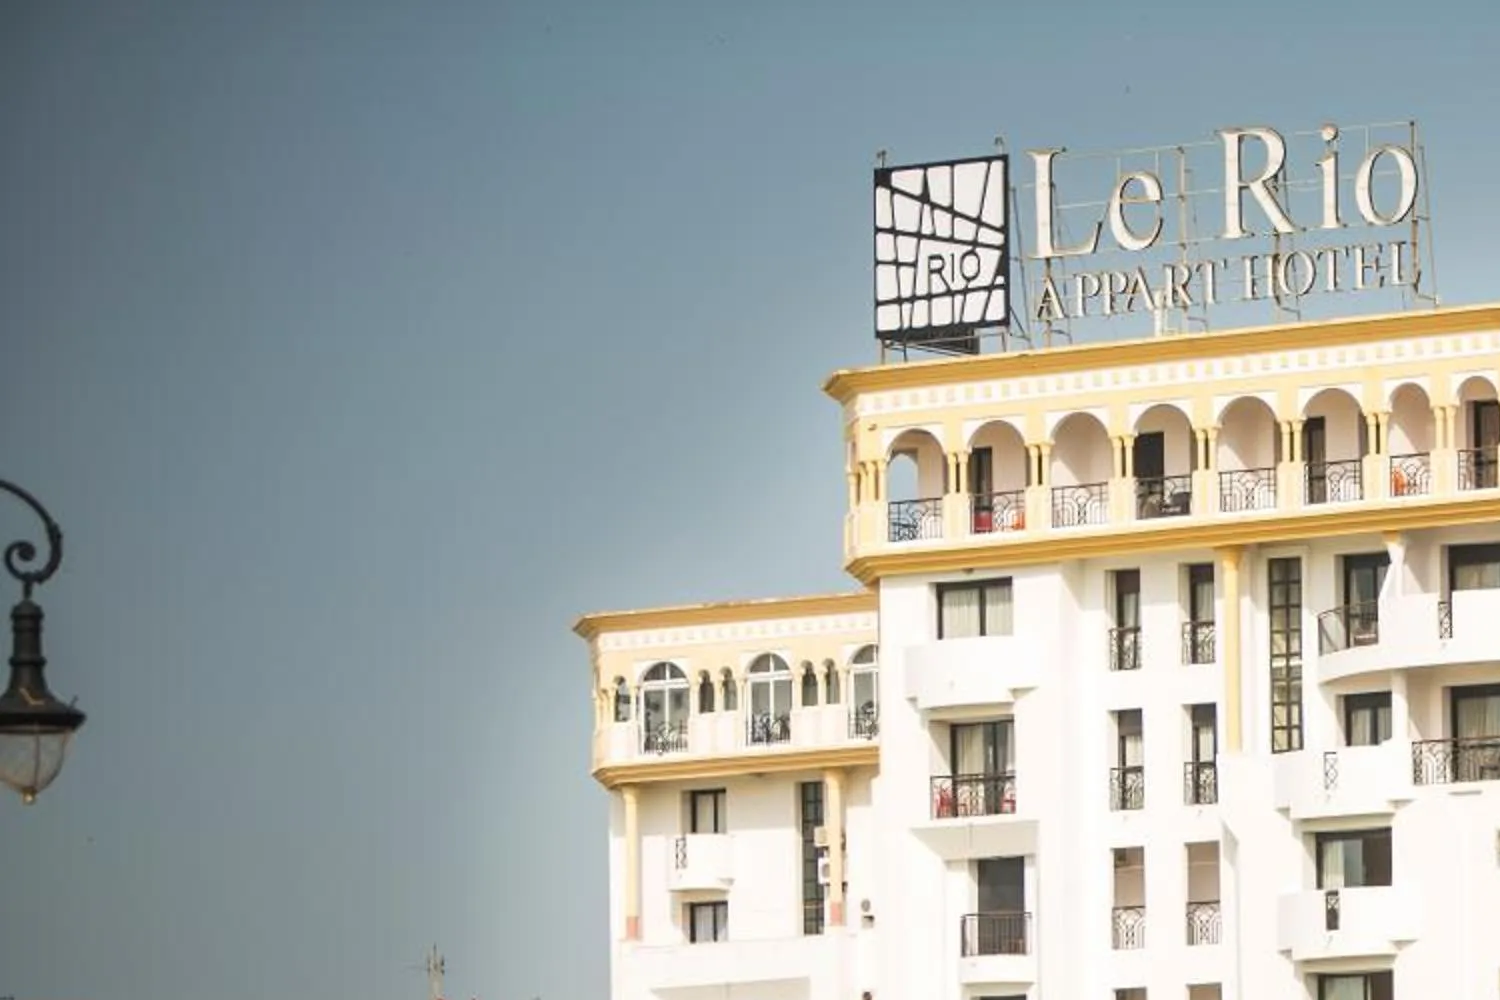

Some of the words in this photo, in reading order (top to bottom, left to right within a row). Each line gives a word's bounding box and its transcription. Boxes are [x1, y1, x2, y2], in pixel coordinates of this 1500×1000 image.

[1026, 147, 1164, 259] Le
[1216, 124, 1420, 240] Rio
[926, 250, 981, 292] RIO
[1036, 258, 1228, 321] APPART
[1240, 240, 1421, 300] HOTEL
